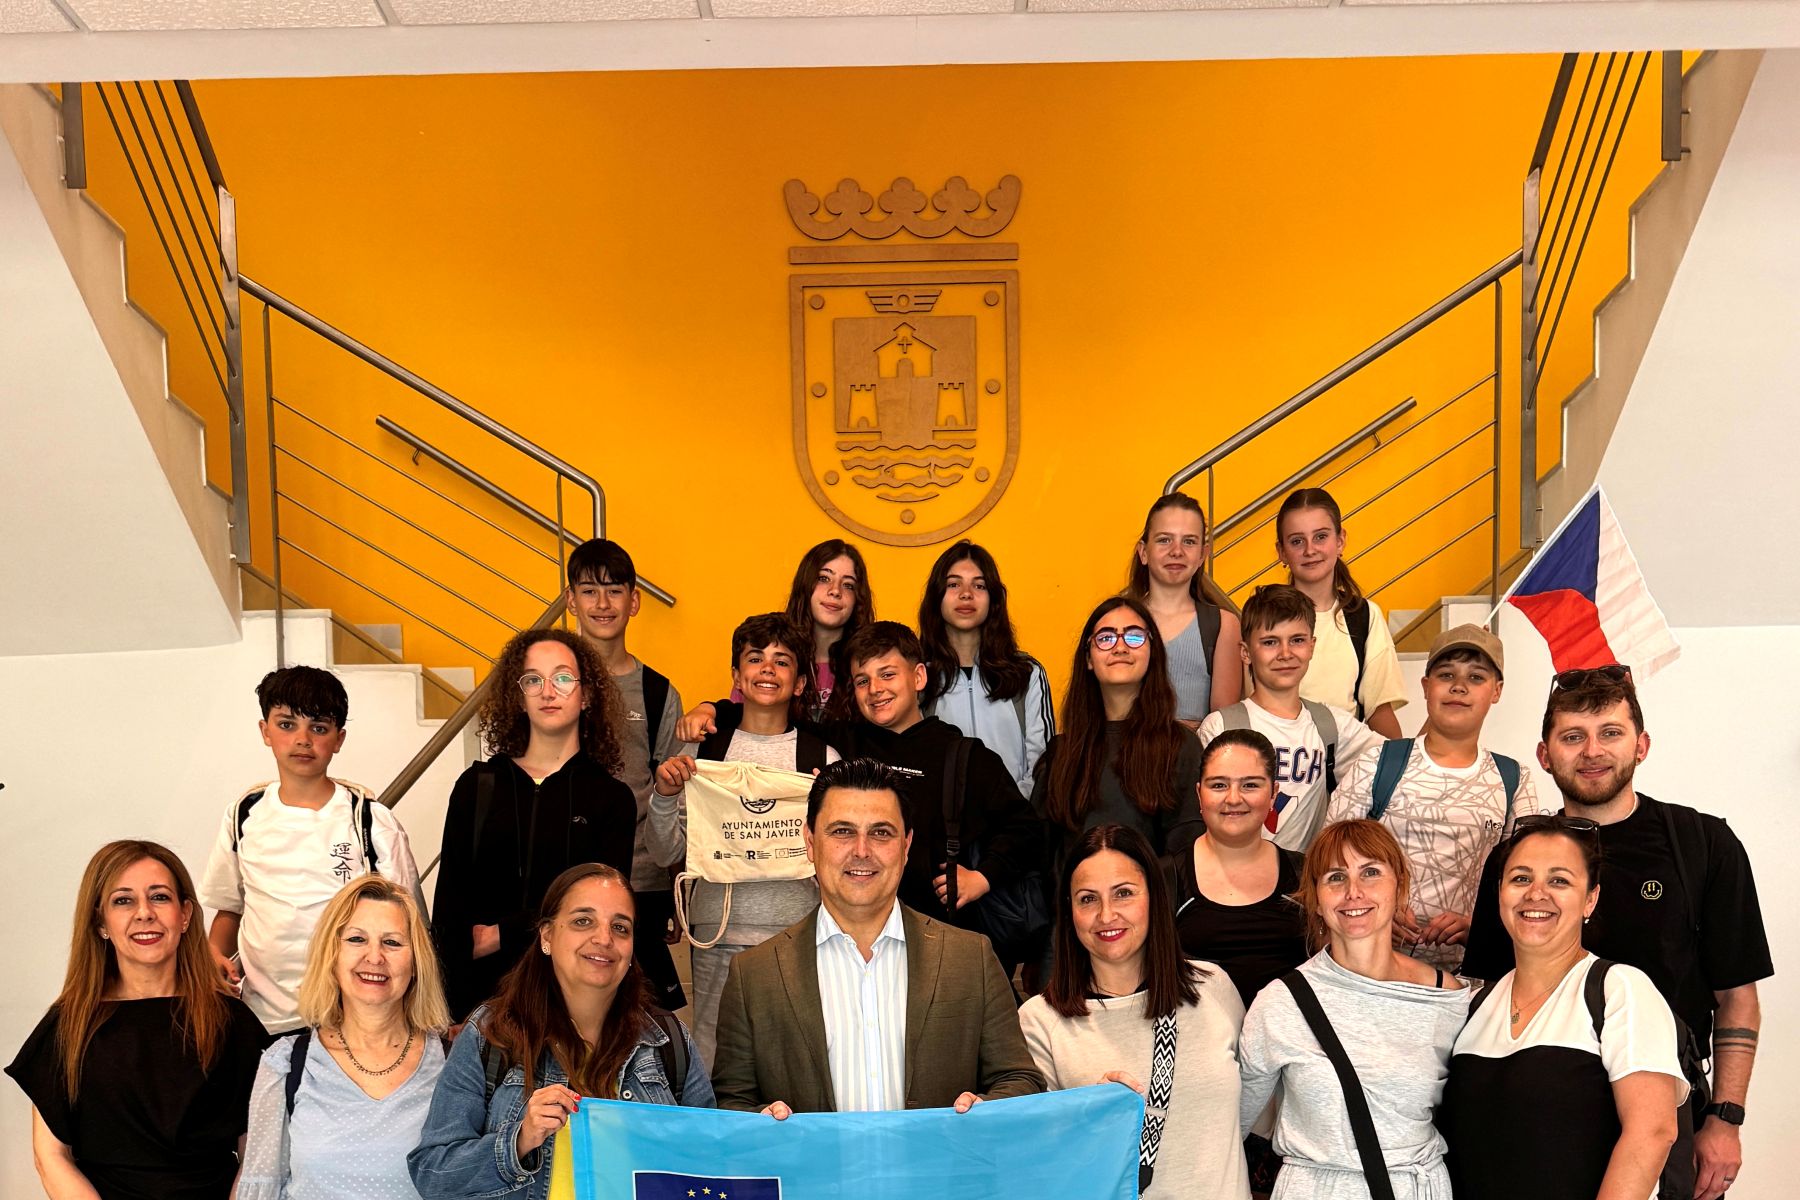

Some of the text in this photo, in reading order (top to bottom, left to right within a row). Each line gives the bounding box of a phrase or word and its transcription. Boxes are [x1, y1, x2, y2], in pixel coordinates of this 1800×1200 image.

[1275, 746, 1323, 784] ECH
[721, 818, 803, 830] AYUNTAMIENTO
[724, 828, 801, 840] DE SAN JAVIER
